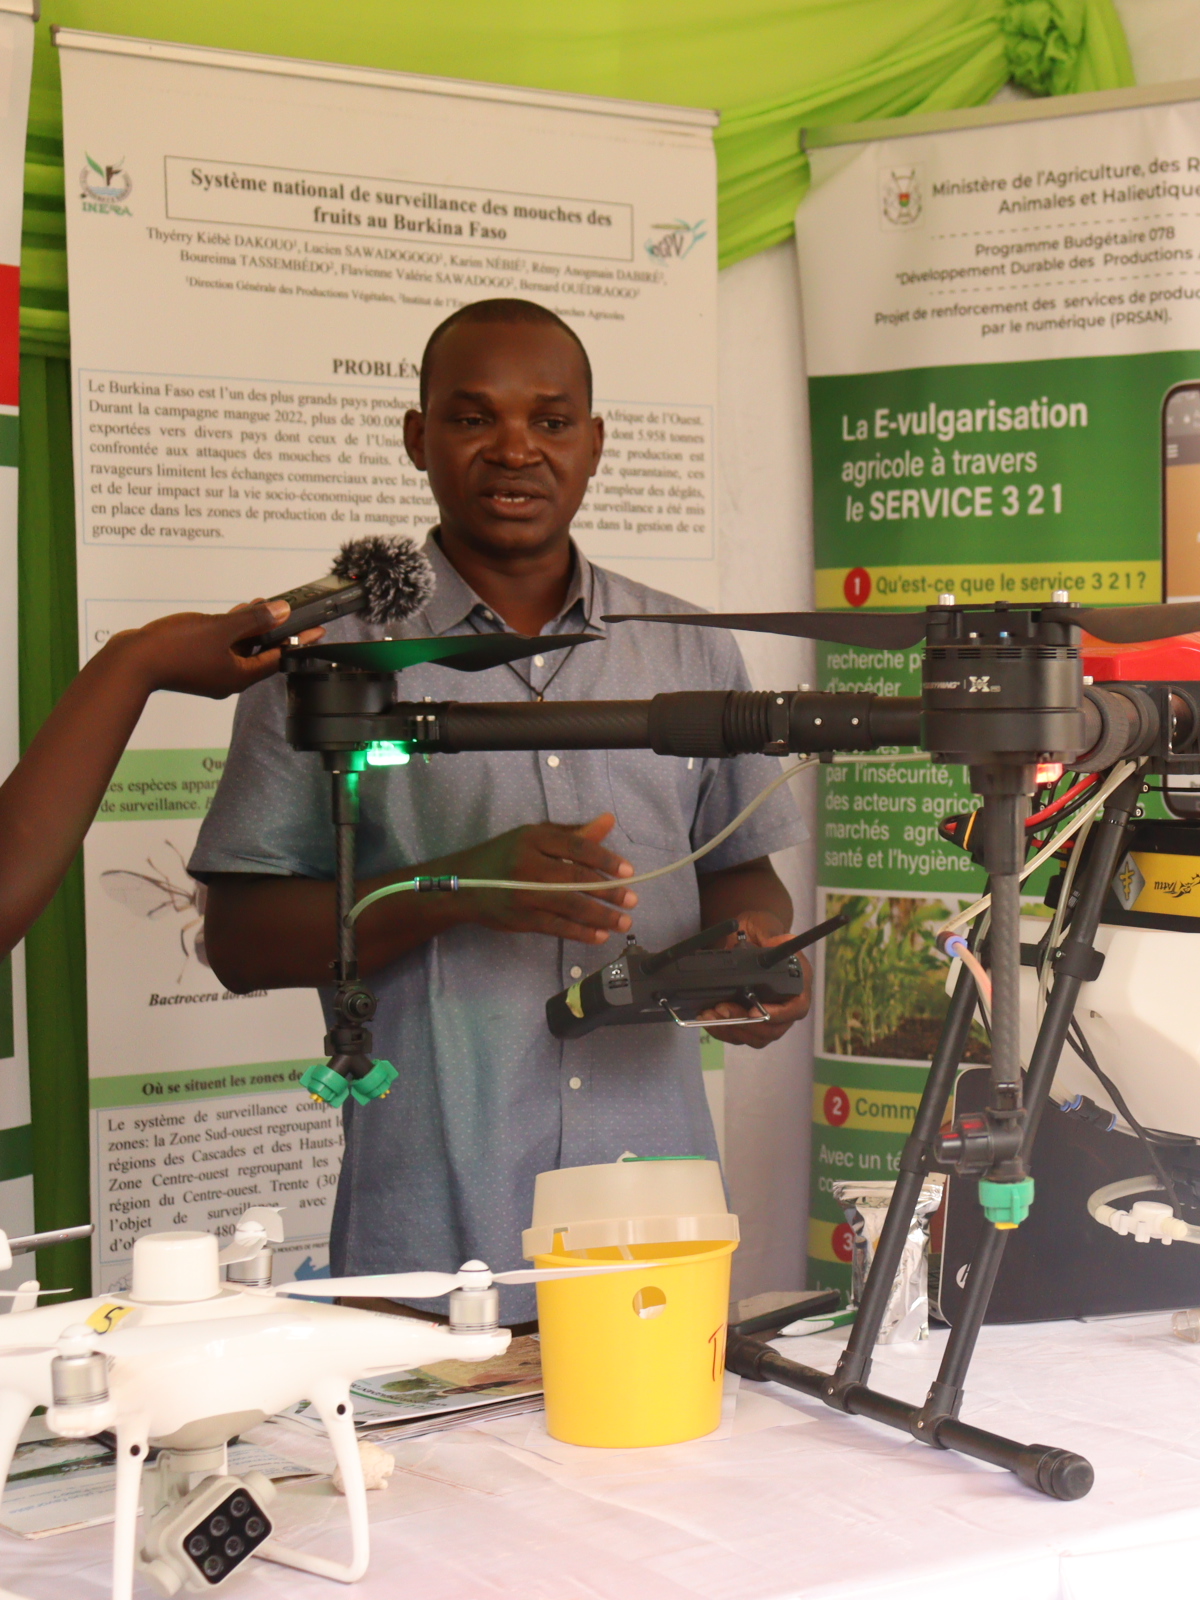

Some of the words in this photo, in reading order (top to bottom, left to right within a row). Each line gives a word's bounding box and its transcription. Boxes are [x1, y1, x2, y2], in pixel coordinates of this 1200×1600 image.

[932, 176, 1007, 197] Ministère
[1013, 173, 1033, 190] de
[1036, 162, 1146, 189] l'Agriculture,
[1149, 157, 1181, 174] des
[191, 167, 267, 191] Système
[273, 180, 344, 199] national
[350, 187, 370, 202] de
[376, 191, 477, 214] surveillance
[482, 198, 508, 216] des
[513, 203, 582, 224] mouches
[587, 210, 612, 226] des
[999, 193, 1075, 214] Animales
[1080, 189, 1097, 204] et
[313, 207, 361, 225] fruits
[368, 216, 387, 228] au
[394, 215, 463, 236] Burkina
[469, 223, 507, 240] Faso
[975, 236, 1059, 257] Programme
[1064, 228, 1146, 249] Budgétaire
[1149, 226, 1175, 242] 078
[896, 262, 1005, 286] "Développement
[1011, 256, 1064, 275] Durable
[1069, 255, 1095, 269] des
[1104, 247, 1193, 266] Productions
[874, 309, 910, 326] Projet
[912, 306, 927, 320] de
[931, 299, 1028, 317] renforcement
[1032, 297, 1056, 311] des
[1064, 293, 1125, 308] services
[1129, 289, 1146, 303] de
[982, 321, 1004, 337] par
[1009, 318, 1022, 332] le
[1026, 313, 1106, 332] numérique
[1110, 309, 1172, 329] (PRSAN).
[88, 380, 105, 393] Le
[109, 381, 160, 396] Burkina
[165, 384, 194, 397] Faso
[198, 388, 215, 398] est
[219, 387, 244, 400] l'un
[247, 390, 267, 402] des
[270, 391, 293, 405] plus
[298, 393, 338, 408] grands
[341, 398, 368, 410] pays
[842, 414, 868, 440] La
[874, 397, 1088, 441] E-vulgarisation
[842, 452, 924, 488] agricole
[931, 448, 945, 476] à
[953, 450, 1037, 475] travers
[846, 495, 864, 521] le
[869, 486, 992, 521] SERVICE
[1001, 485, 1020, 516] 3
[1028, 484, 1044, 514] 2
[1052, 483, 1062, 514] 1
[854, 577, 861, 595] 1
[876, 576, 954, 594] Qu'est-ce
[961, 577, 995, 600] que
[1001, 573, 1015, 591] le
[1021, 572, 1085, 591] service
[1092, 571, 1102, 590] 3
[1110, 572, 1119, 589] 2
[1125, 572, 1131, 589] 1
[1137, 571, 1146, 588] ?
[825, 848, 862, 867] santé
[867, 850, 883, 868] et
[888, 848, 975, 875] l'hygiène.
[142, 1082, 163, 1096] Où
[168, 1083, 180, 1093] se
[184, 1076, 226, 1091] situent
[231, 1073, 246, 1086] les
[251, 1074, 284, 1084] zones
[108, 1119, 125, 1132] Le
[134, 1114, 185, 1133] système
[194, 1111, 207, 1123] de
[216, 1104, 288, 1120] surveillance
[108, 1136, 149, 1152] zones:
[154, 1134, 165, 1147] la
[170, 1131, 201, 1146] Zone
[205, 1124, 263, 1140] Sud-ouest
[267, 1119, 331, 1136] regroupant
